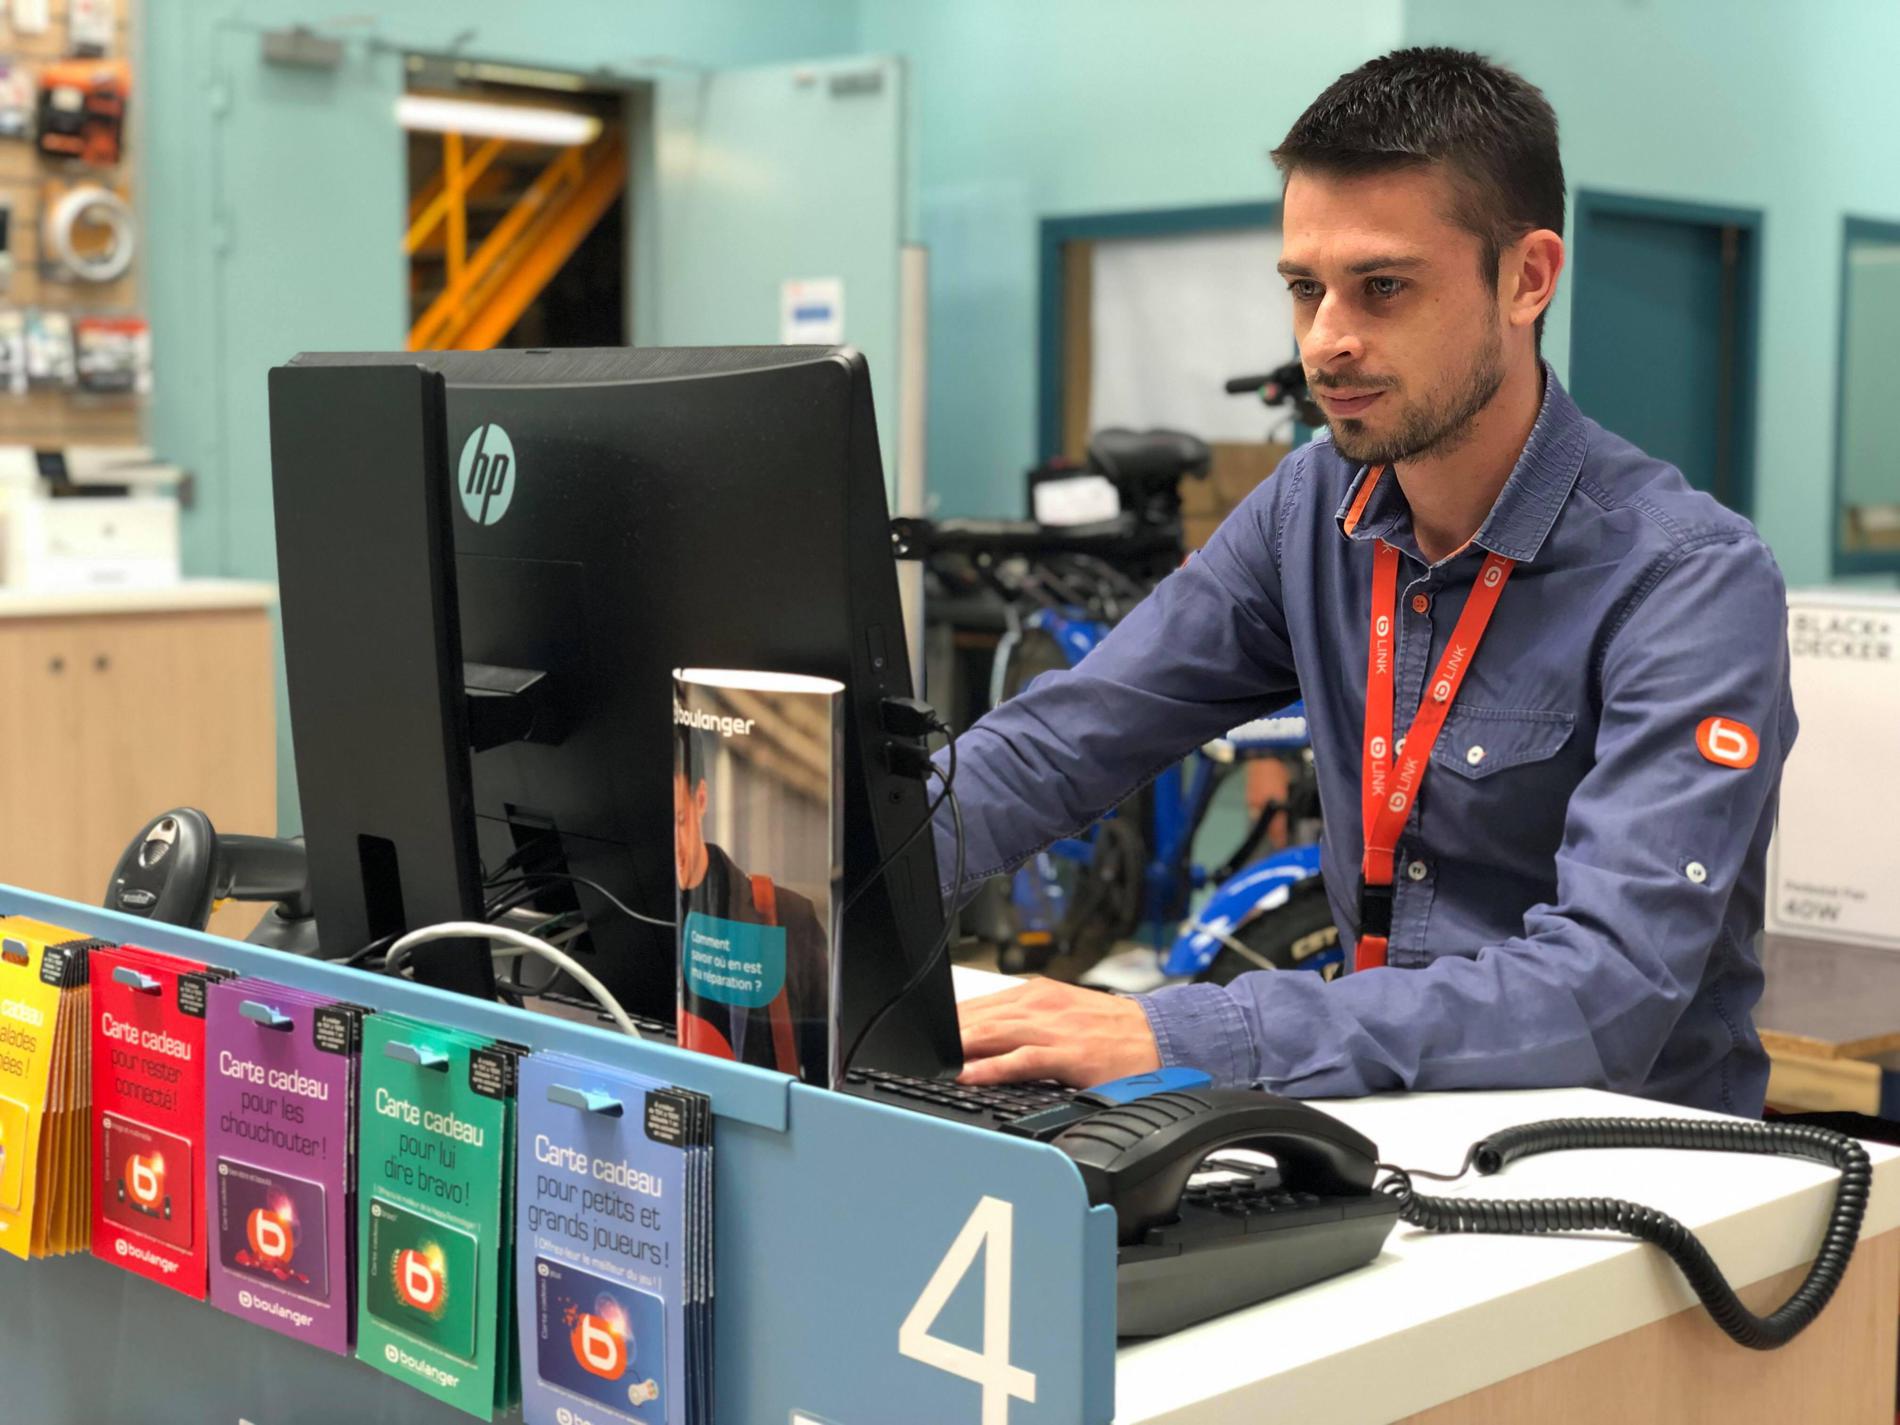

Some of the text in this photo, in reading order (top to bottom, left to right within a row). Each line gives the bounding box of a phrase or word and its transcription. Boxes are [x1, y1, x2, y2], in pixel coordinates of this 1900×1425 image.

[461, 424, 512, 525] hp
[1376, 639, 1388, 675] LINK
[1443, 644, 1467, 681] LINK
[1372, 761, 1385, 797] LINK
[1396, 757, 1419, 792] LINK
[691, 930, 730, 952] Comment
[703, 969, 753, 992] réparation
[755, 980, 763, 992] ?
[714, 955, 726, 969] où
[728, 960, 742, 972] en
[743, 962, 763, 975] est
[102, 1012, 192, 1061] Carte cadeau
[111, 1048, 183, 1084] pour rester
[219, 1050, 328, 1101] Carte cadeau
[240, 1091, 305, 1124] pour les
[375, 1087, 484, 1148] Carte cadeau
[399, 1134, 456, 1169] pour lui
[535, 1134, 662, 1198] Carte cadeau
[384, 1156, 414, 1186] dire
[537, 1175, 662, 1232] pour petits et
[528, 1204, 589, 1242] grands
[127, 1243, 180, 1274] boulanger
[253, 1296, 314, 1327] boulanger
[898, 1195, 1037, 1425] 4
[399, 1348, 460, 1388] boulanger
